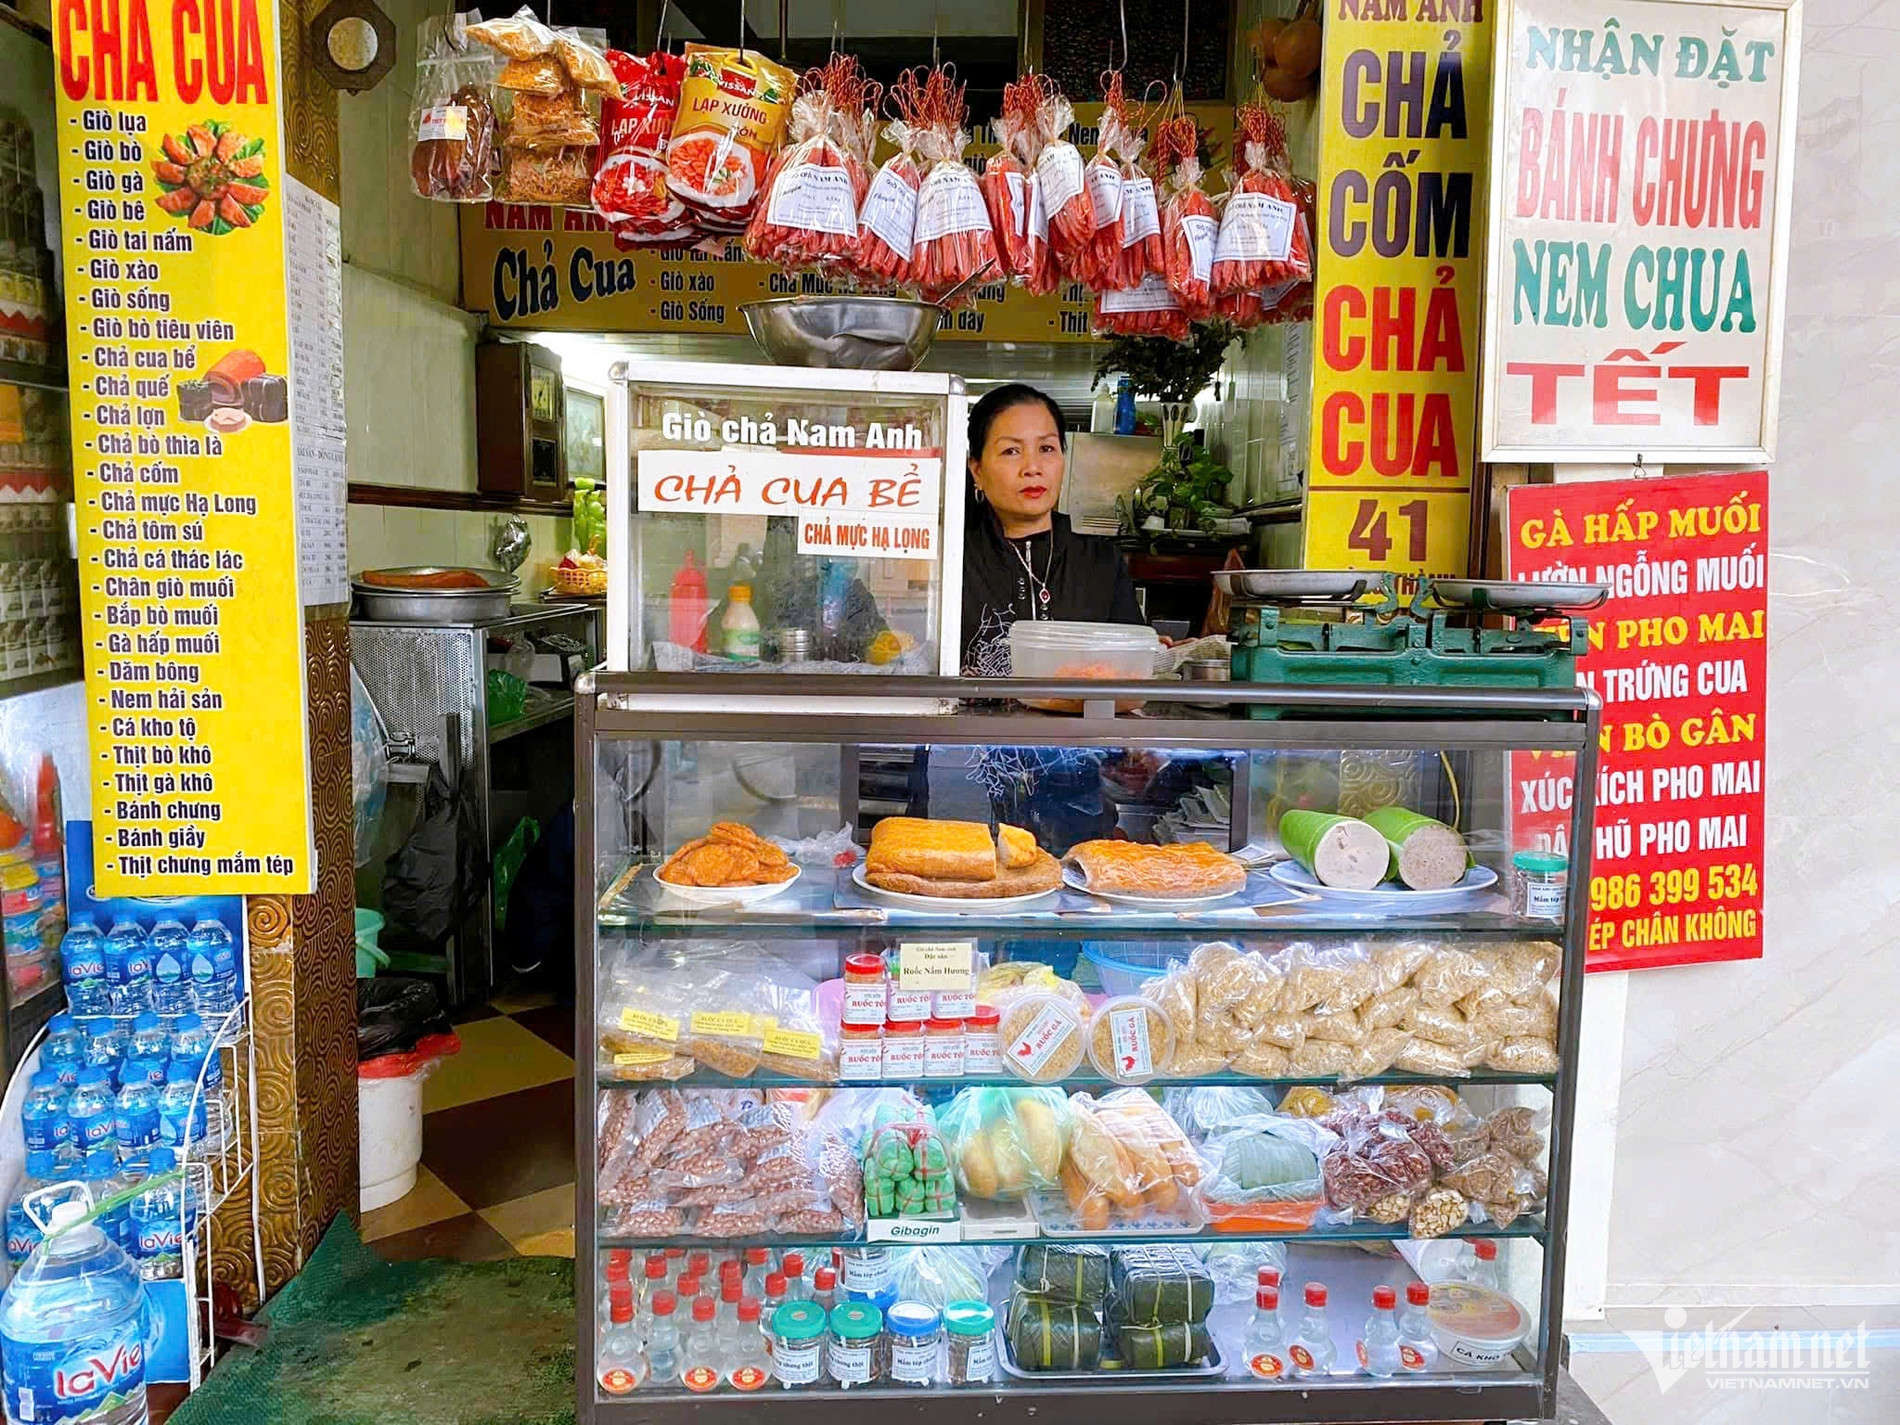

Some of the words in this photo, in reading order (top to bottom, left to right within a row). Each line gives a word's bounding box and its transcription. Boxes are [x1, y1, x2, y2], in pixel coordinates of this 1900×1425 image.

[1338, 0, 1407, 22] NAM
[1416, 0, 1483, 22] ANH
[172, 0, 268, 105] CUA
[1526, 17, 1664, 80] NHẬN
[1675, 25, 1775, 88] ĐẶT
[1341, 30, 1467, 139] CHẢ
[83, 111, 112, 131] Giò
[119, 112, 146, 133] lụa
[85, 141, 114, 161] Giò
[120, 140, 142, 162] bò
[1516, 88, 1624, 223] BÁNH
[1632, 109, 1766, 229] CHƯNG
[86, 170, 116, 190] Giò
[122, 171, 143, 195] gà
[88, 200, 117, 220] Giò
[123, 201, 144, 221] bê
[1329, 149, 1473, 258] CỐM
[89, 230, 118, 249] Giò
[123, 232, 147, 251] tai
[153, 226, 192, 252] nấm
[90, 259, 120, 279] Giò
[126, 259, 158, 280] xào
[493, 239, 559, 321] Chả
[570, 247, 636, 304] Cua
[660, 270, 684, 292] Giò
[688, 270, 715, 292] xào
[92, 289, 121, 308] Giò
[127, 286, 170, 312] sống
[1513, 239, 1612, 328] NEM
[1624, 245, 1756, 333] CHUA
[660, 299, 684, 320] Giò
[688, 297, 725, 324] Sống
[1322, 265, 1465, 372] CHẢ
[93, 318, 123, 338] Giò
[129, 318, 150, 339] bò
[156, 320, 190, 339] tiêu
[196, 321, 234, 340] viên
[95, 346, 128, 368] Chả
[135, 350, 167, 368] cua
[173, 345, 196, 368] bể
[96, 375, 129, 396] Chả
[136, 373, 170, 401] quế
[1507, 342, 1749, 425] TẾT
[97, 404, 130, 425] Chả
[137, 407, 165, 430] lợn
[662, 412, 711, 442] Giò
[722, 413, 776, 444] chả
[787, 419, 855, 448] Nam
[865, 422, 922, 449] Anh
[1321, 391, 1459, 477] CUA
[98, 433, 132, 453] Chả
[138, 434, 160, 455] bò
[165, 434, 200, 455] thìa
[206, 434, 222, 455] là
[100, 462, 133, 483] Chả
[140, 462, 179, 484] cốm
[654, 465, 741, 505] CHẢ
[762, 476, 847, 506] CUA
[868, 463, 922, 507] BỂ
[101, 491, 134, 511] Chả
[142, 493, 180, 516] mực
[186, 494, 208, 517] Hạ
[214, 495, 256, 515] Long
[103, 518, 137, 540] Chả
[143, 521, 177, 540] tôm
[183, 521, 203, 540] sú
[1348, 500, 1428, 561] 41
[1520, 509, 1574, 549] GÀ
[1584, 498, 1659, 543] HẤP
[1668, 490, 1761, 539] MUỐI
[805, 517, 832, 545] CHẢ
[872, 528, 890, 552] HẠ
[104, 547, 137, 568] Chả
[145, 549, 165, 568] cá
[171, 550, 210, 569] thác
[216, 550, 243, 570] lác
[1596, 550, 1687, 599] NGỖNG
[1697, 542, 1764, 592] MUỐI
[106, 578, 150, 596] Chân
[157, 578, 184, 601] giò
[190, 575, 234, 597] muối
[107, 605, 141, 628] Bắp
[147, 606, 167, 625] bò
[174, 603, 218, 626] muối
[1617, 616, 1688, 649] PHO
[1699, 610, 1765, 643] MAI
[109, 633, 132, 653] Gà
[137, 632, 170, 656] hấp
[176, 631, 219, 654] muối
[110, 662, 149, 681] Dăm
[156, 662, 199, 686] bông
[1603, 660, 1688, 703] TRỨNG
[1697, 659, 1747, 696] CUA
[111, 691, 152, 709] Nem
[158, 688, 185, 709] hải
[192, 689, 222, 709] sản
[113, 717, 134, 736] Cá
[141, 718, 173, 737] kho
[180, 718, 195, 740] tộ
[1624, 713, 1670, 750] BÒ
[1680, 708, 1757, 747] GÂN
[114, 747, 147, 767] Thịt
[152, 746, 173, 764] bò
[180, 745, 211, 764] khô
[116, 774, 148, 795] Thịt
[155, 773, 175, 796] gà
[181, 772, 213, 792] khô
[1521, 772, 1573, 814] XÚC
[1652, 765, 1703, 801] PHO
[1711, 760, 1760, 796] MAI
[117, 801, 162, 819] Bánh
[168, 802, 221, 824] chưng
[118, 828, 162, 847] Bánh
[169, 826, 205, 852] giầy
[1595, 818, 1632, 860] HŨ
[1640, 820, 1690, 855] PHO
[1699, 815, 1747, 850] MAI
[119, 856, 151, 876] Thịt
[157, 858, 212, 878] chưng
[218, 853, 261, 874] mắm
[267, 855, 293, 878] tép
[1590, 874, 1640, 911] 986
[1650, 868, 1699, 905] 399
[1708, 863, 1757, 900] 534
[1588, 918, 1615, 950] ÉP
[1622, 907, 1679, 948] CHÂN
[1685, 906, 1756, 941] KHÔNG
[890, 1225, 940, 1237] Gibagin
